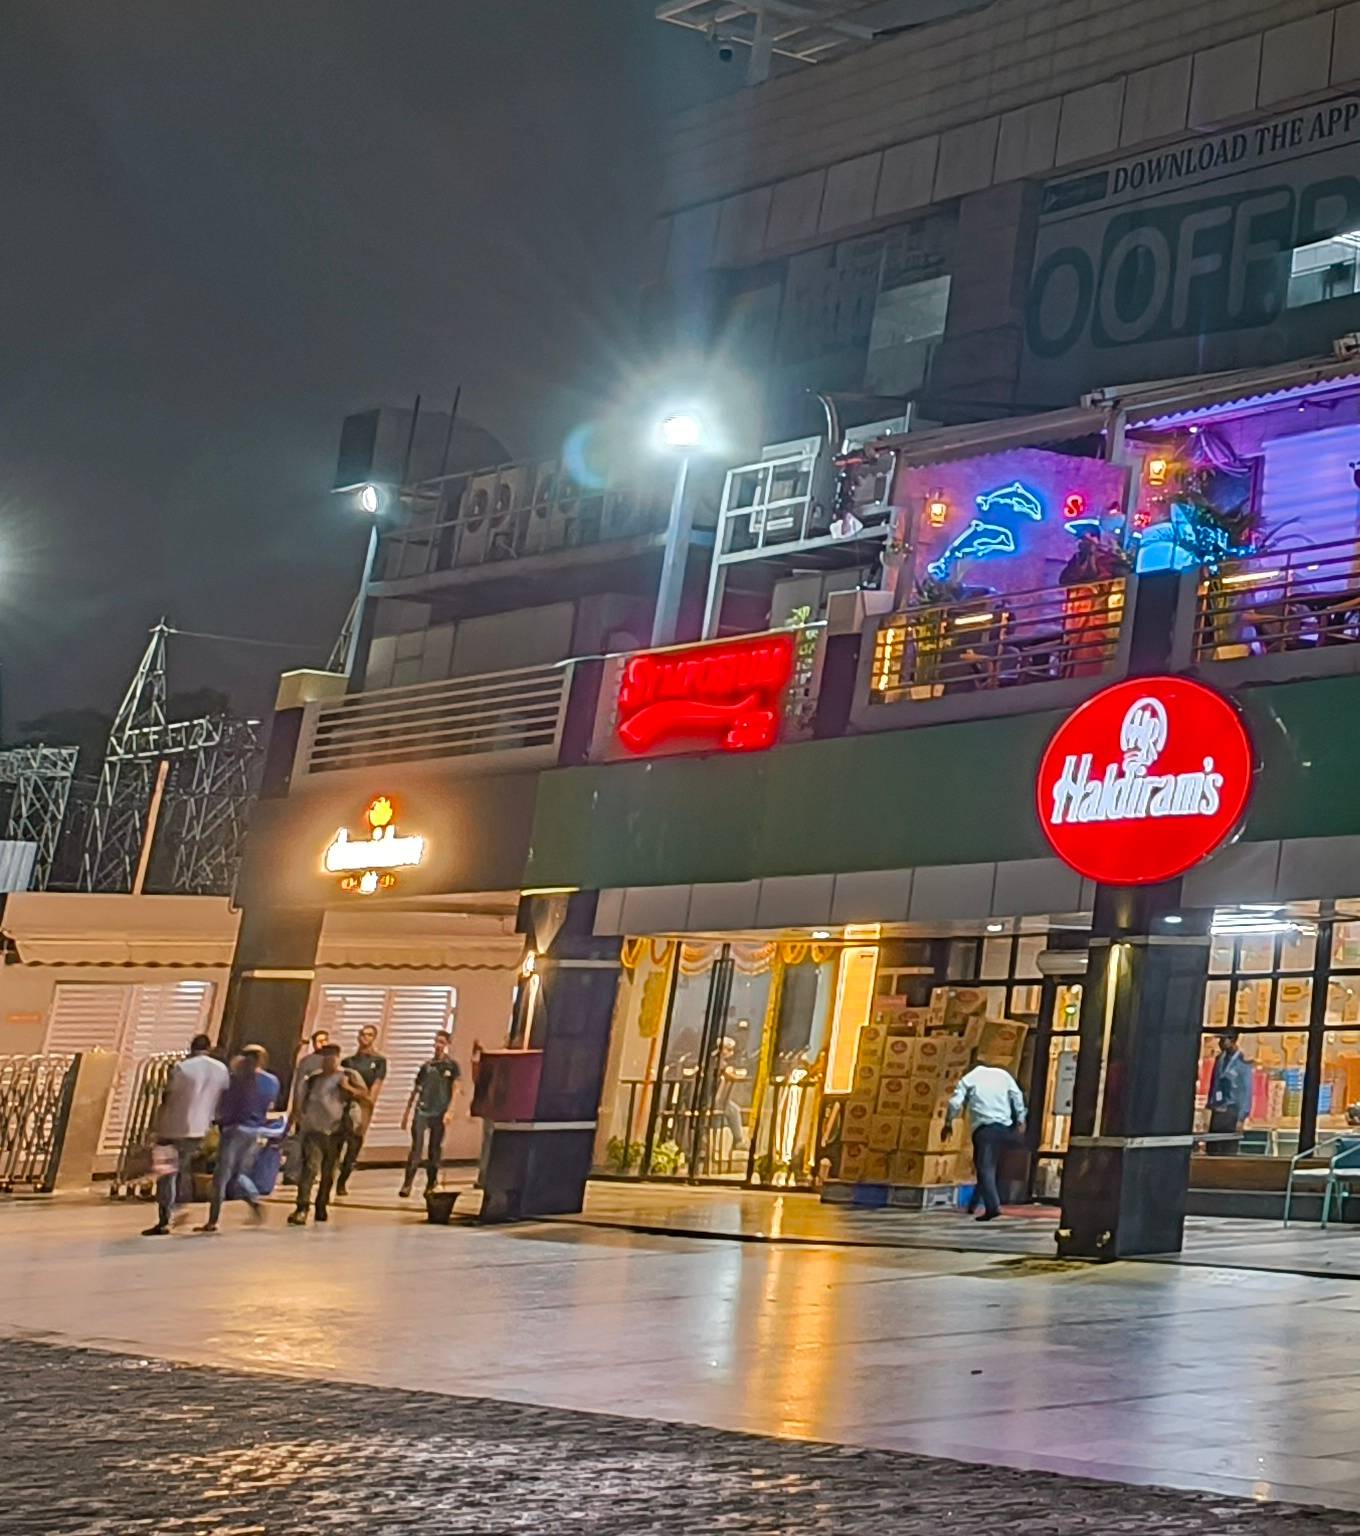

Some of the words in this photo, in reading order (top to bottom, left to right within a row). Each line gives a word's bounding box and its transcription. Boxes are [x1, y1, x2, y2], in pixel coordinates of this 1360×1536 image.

[1112, 134, 1248, 195] DOWNLOAD
[1255, 119, 1302, 156] THE
[1308, 102, 1360, 142] APP
[1050, 753, 1224, 825] Haldiram's
